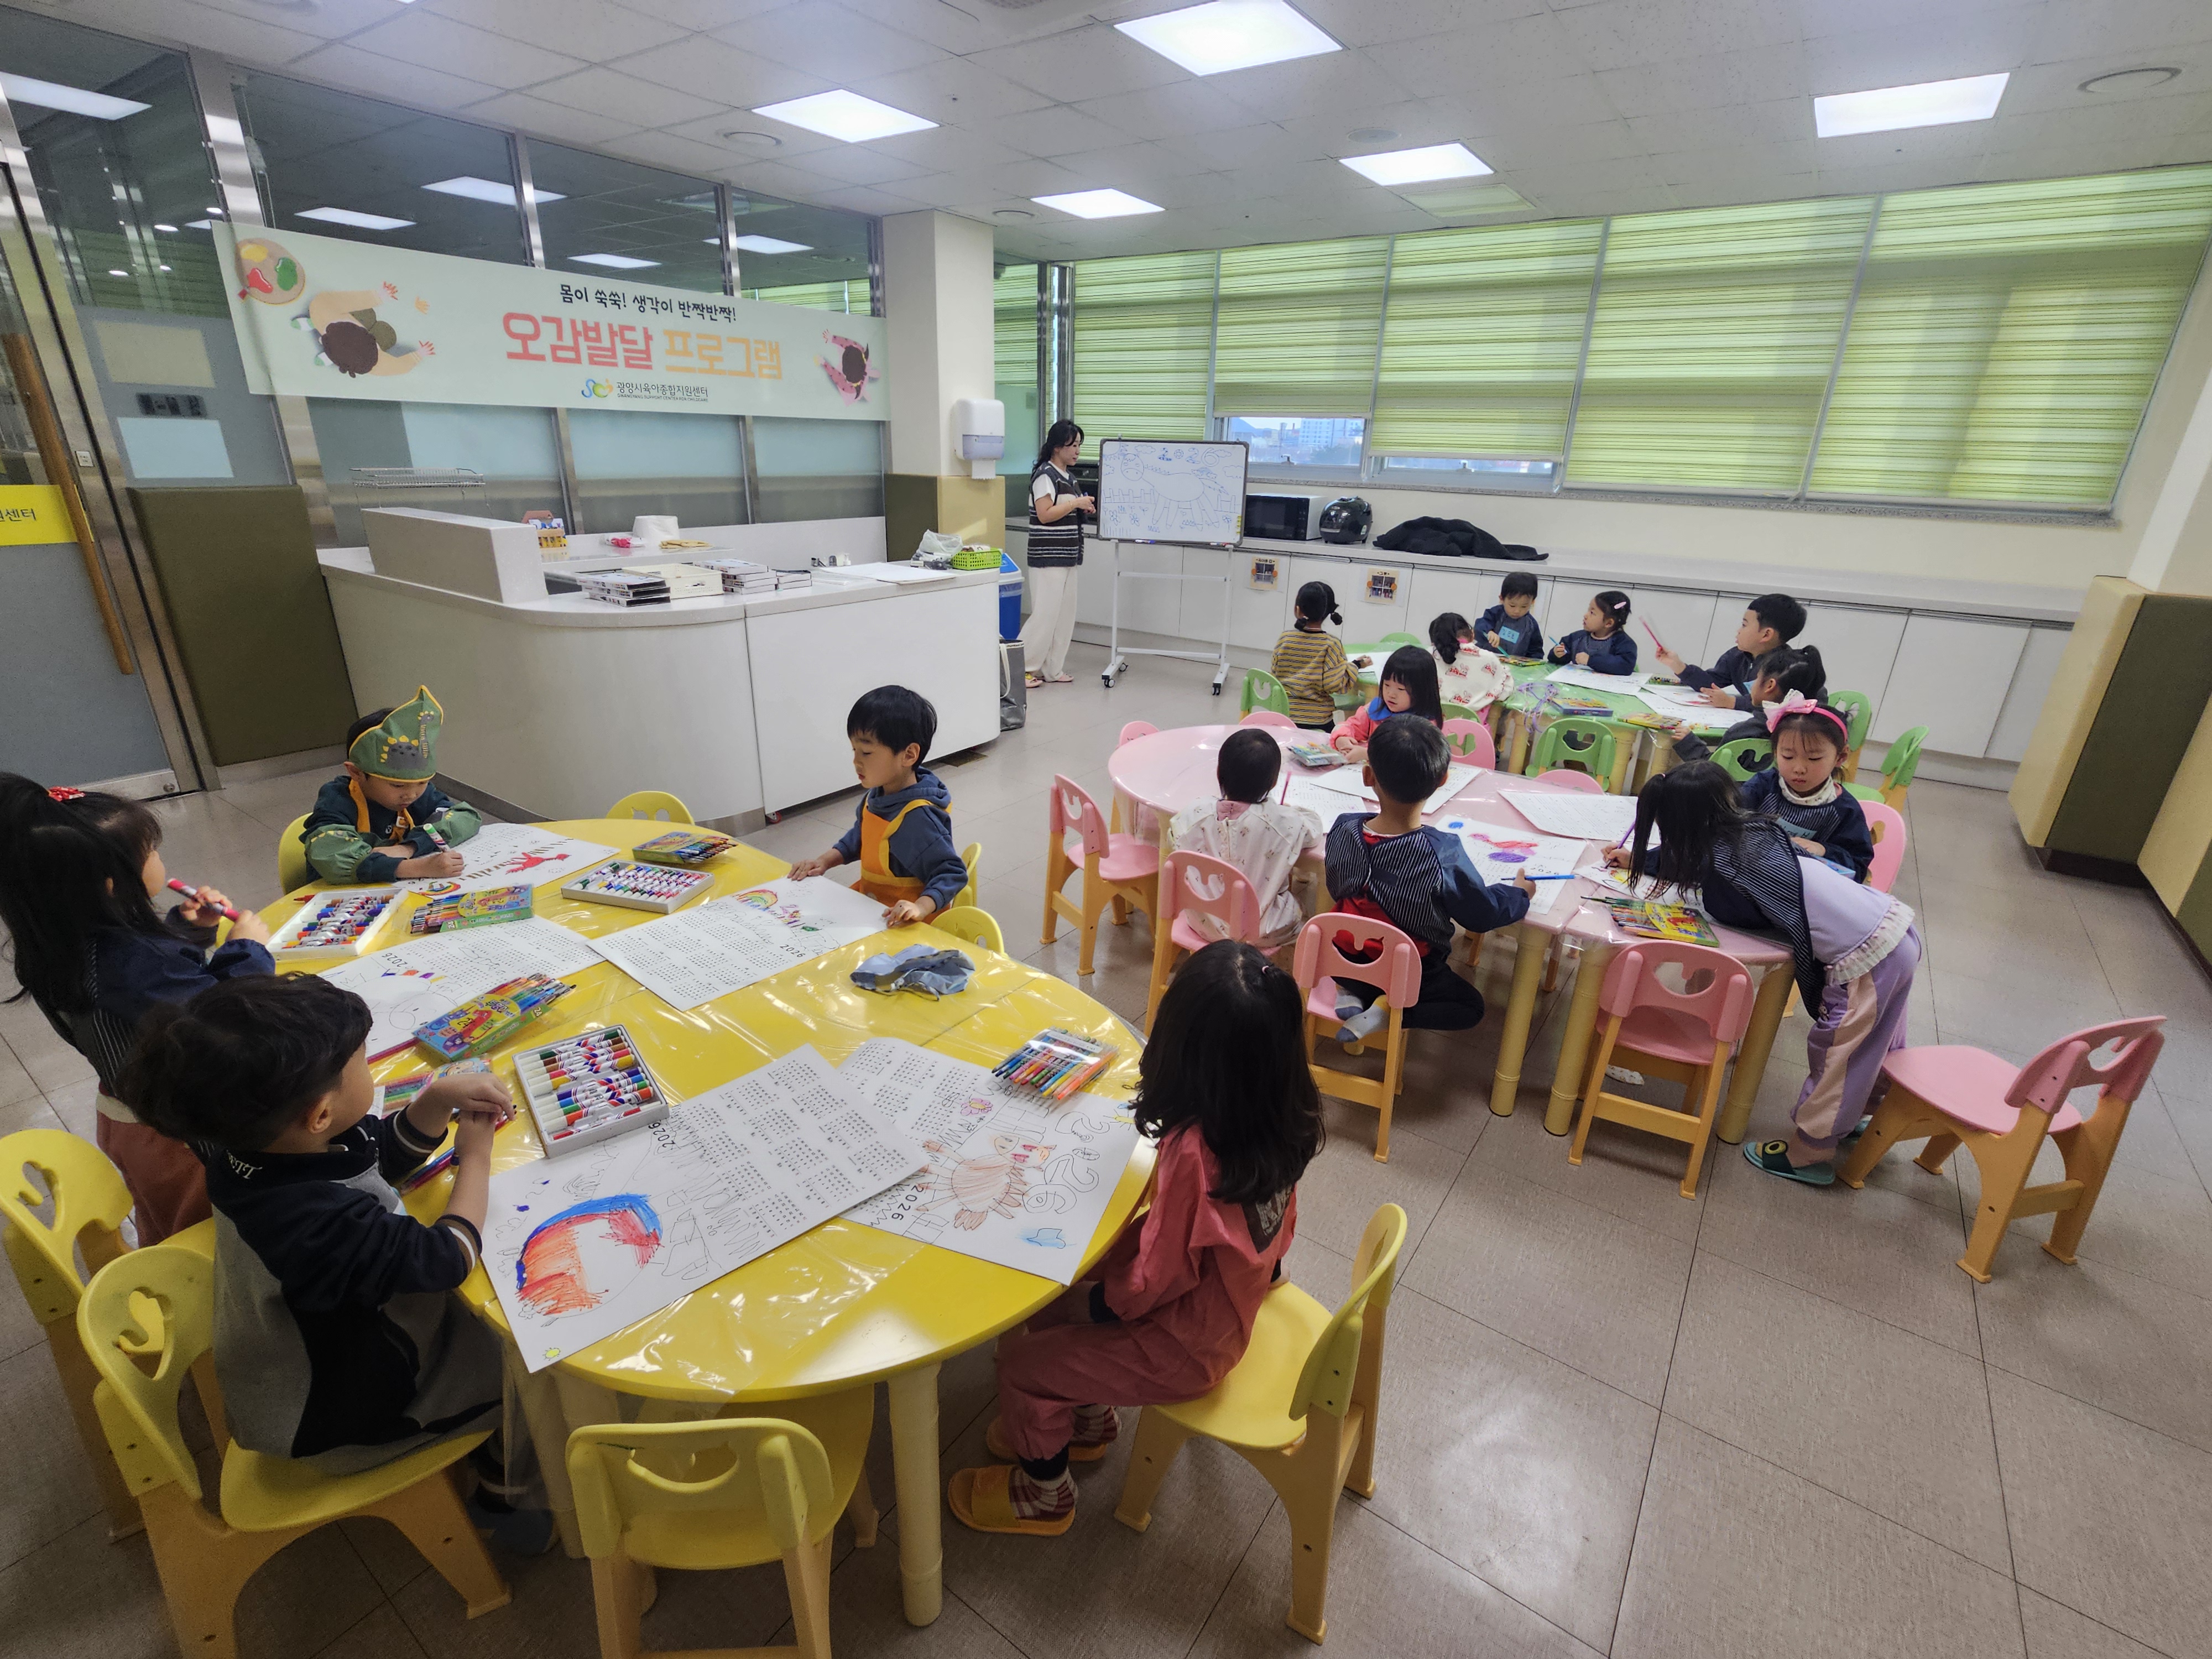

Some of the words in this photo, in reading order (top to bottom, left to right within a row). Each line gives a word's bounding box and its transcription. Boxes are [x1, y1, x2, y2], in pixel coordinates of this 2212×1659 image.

[560, 283, 589, 304] 몸이
[594, 289, 627, 309] 쑥쑥!
[632, 295, 673, 315] 생각이
[677, 300, 737, 324] 반짝반짝!
[502, 312, 654, 370] 오감발달
[663, 329, 782, 380] 프로그램
[616, 382, 708, 398] 광양시육아종합지원센터
[381, 952, 408, 967] 2026
[779, 944, 806, 958] 2026
[534, 1006, 542, 1018] 24
[648, 1122, 675, 1148] 2026
[891, 1185, 924, 1220] 2026
